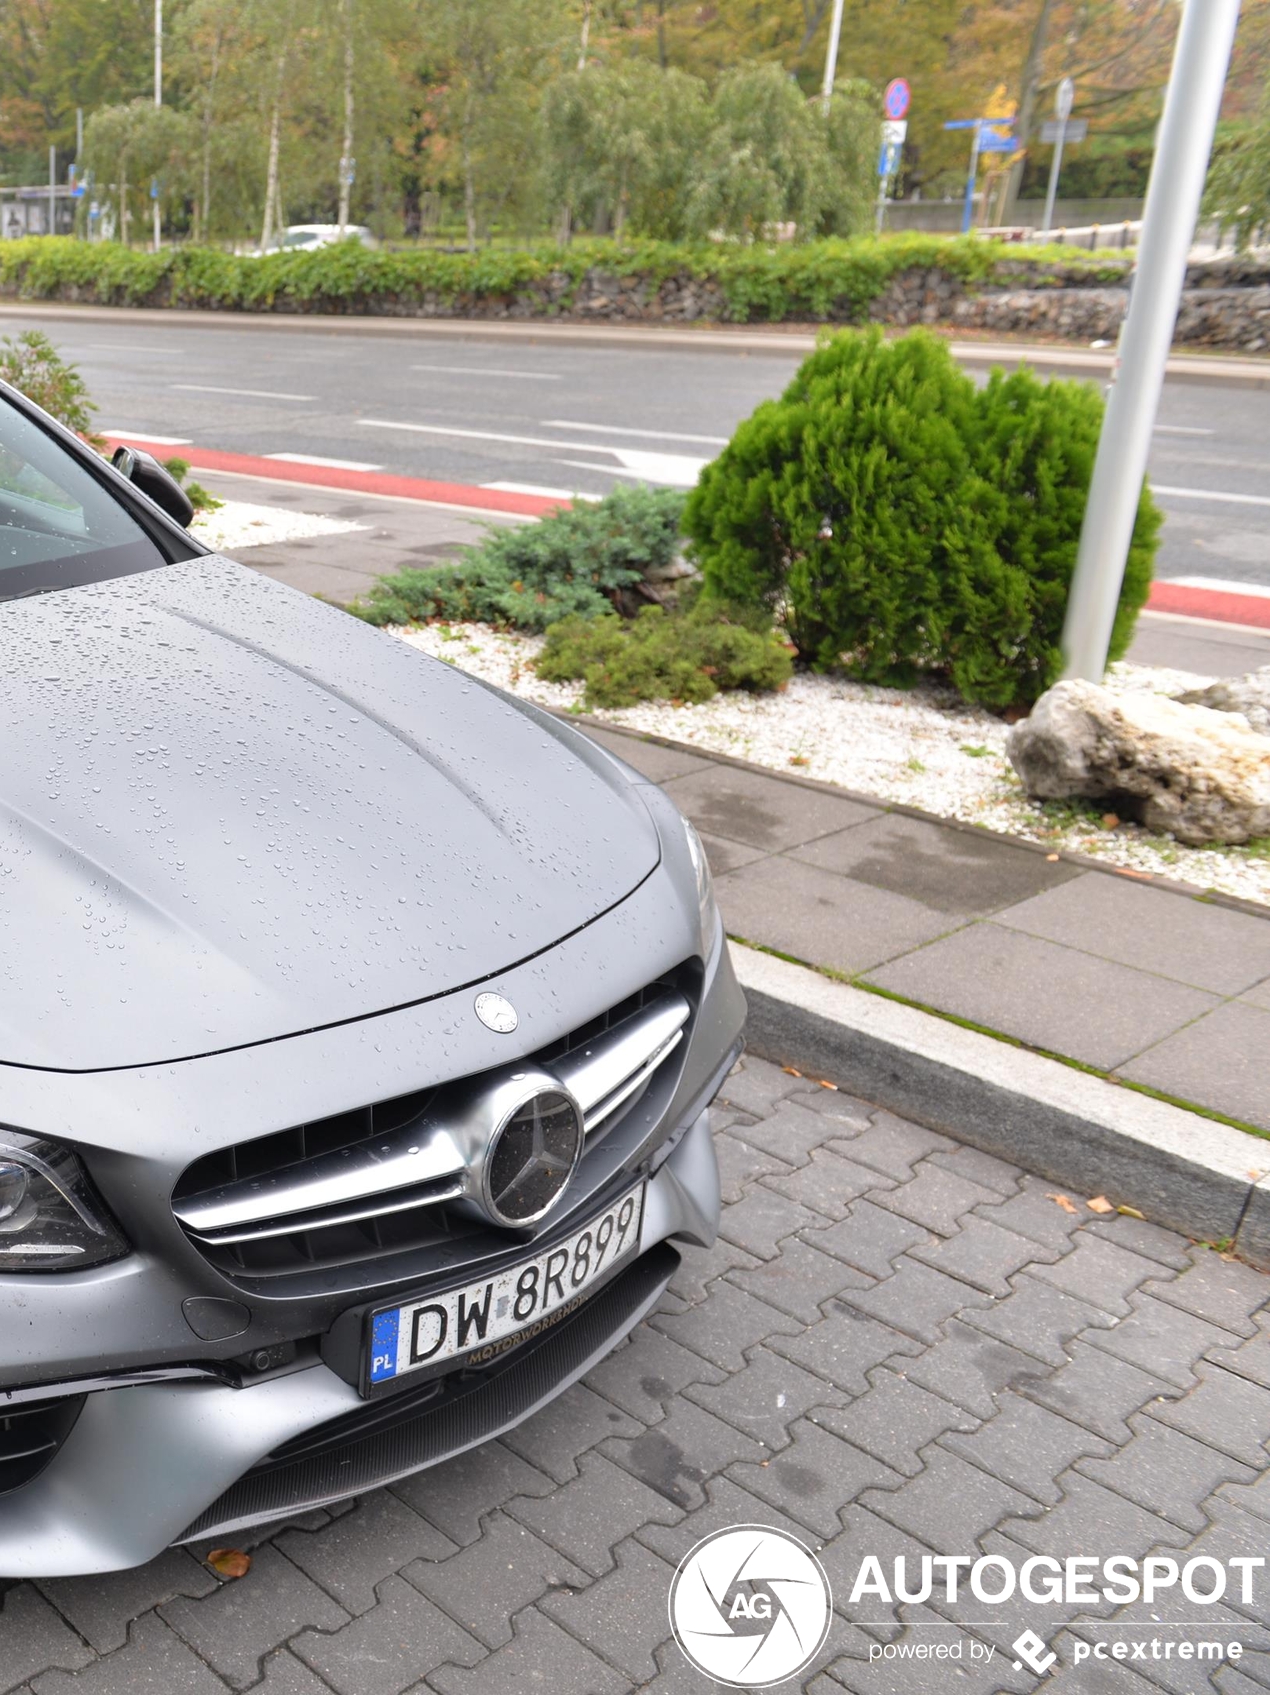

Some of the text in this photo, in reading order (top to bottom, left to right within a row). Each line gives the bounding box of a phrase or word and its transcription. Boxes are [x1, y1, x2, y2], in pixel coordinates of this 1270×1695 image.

[410, 1196, 634, 1365] DW 8R899
[372, 1353, 393, 1374] PL
